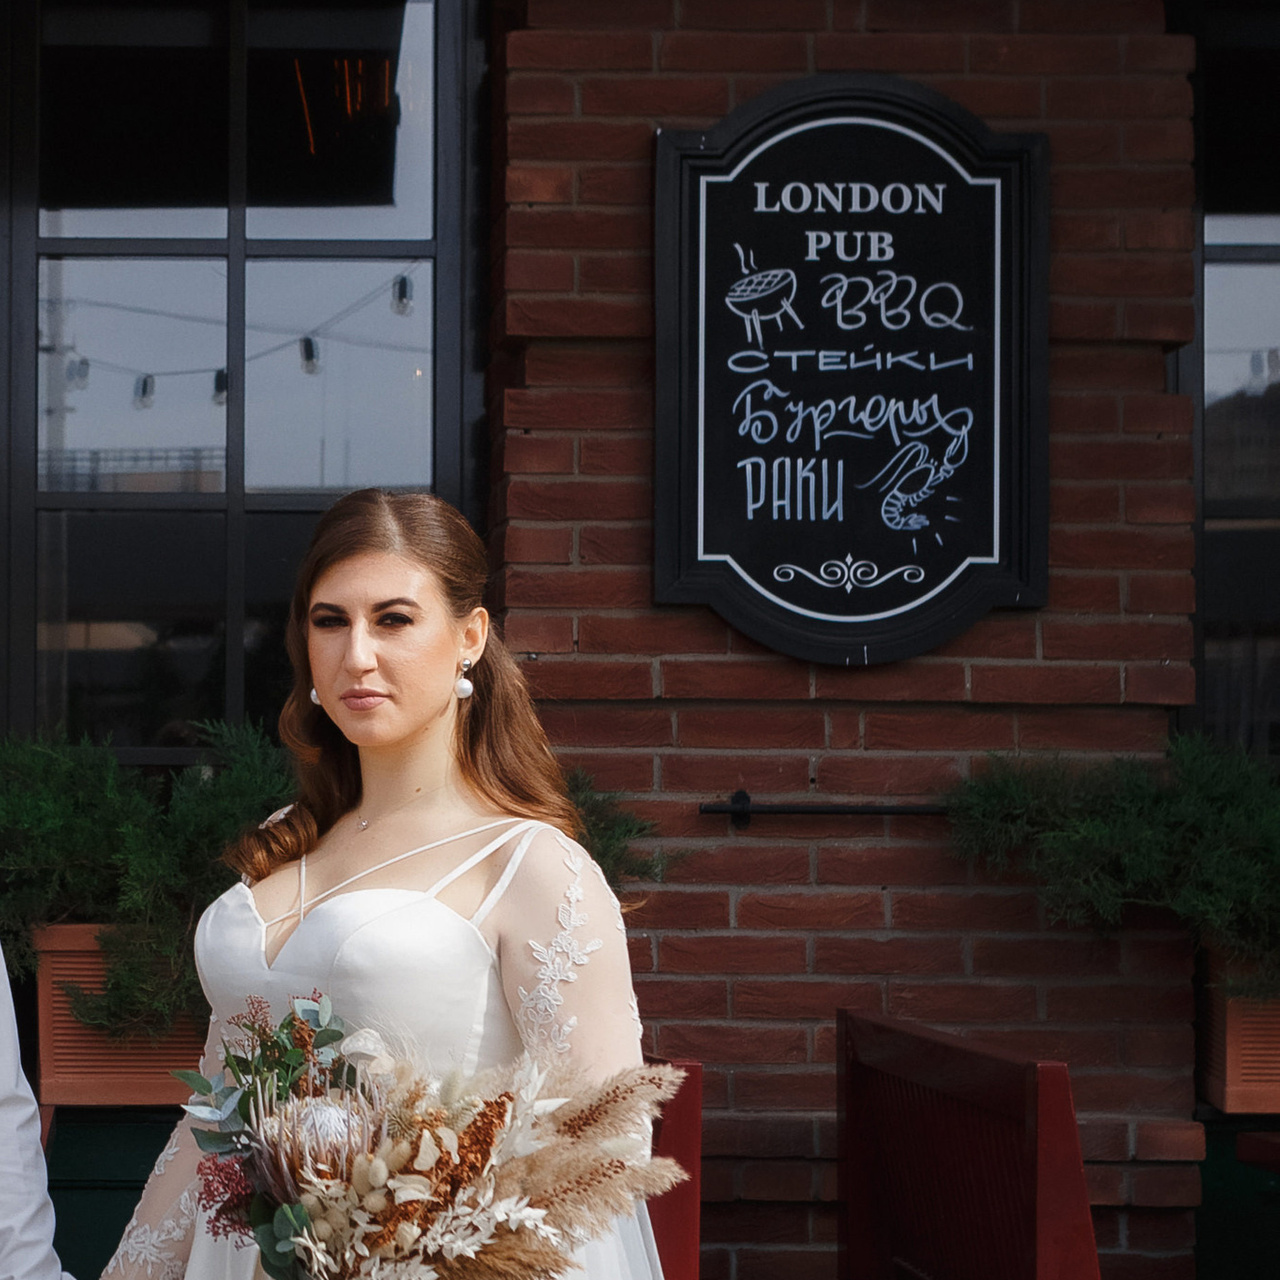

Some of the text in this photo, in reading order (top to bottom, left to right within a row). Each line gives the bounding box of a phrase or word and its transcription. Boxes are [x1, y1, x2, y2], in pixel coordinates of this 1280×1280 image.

[753, 182, 946, 214] LONDON
[804, 230, 895, 262] PUB
[819, 269, 974, 331] BBQ
[727, 343, 974, 373] СТЕЙКИ
[732, 378, 974, 452] Бургеры
[736, 456, 844, 522] РАКИ
